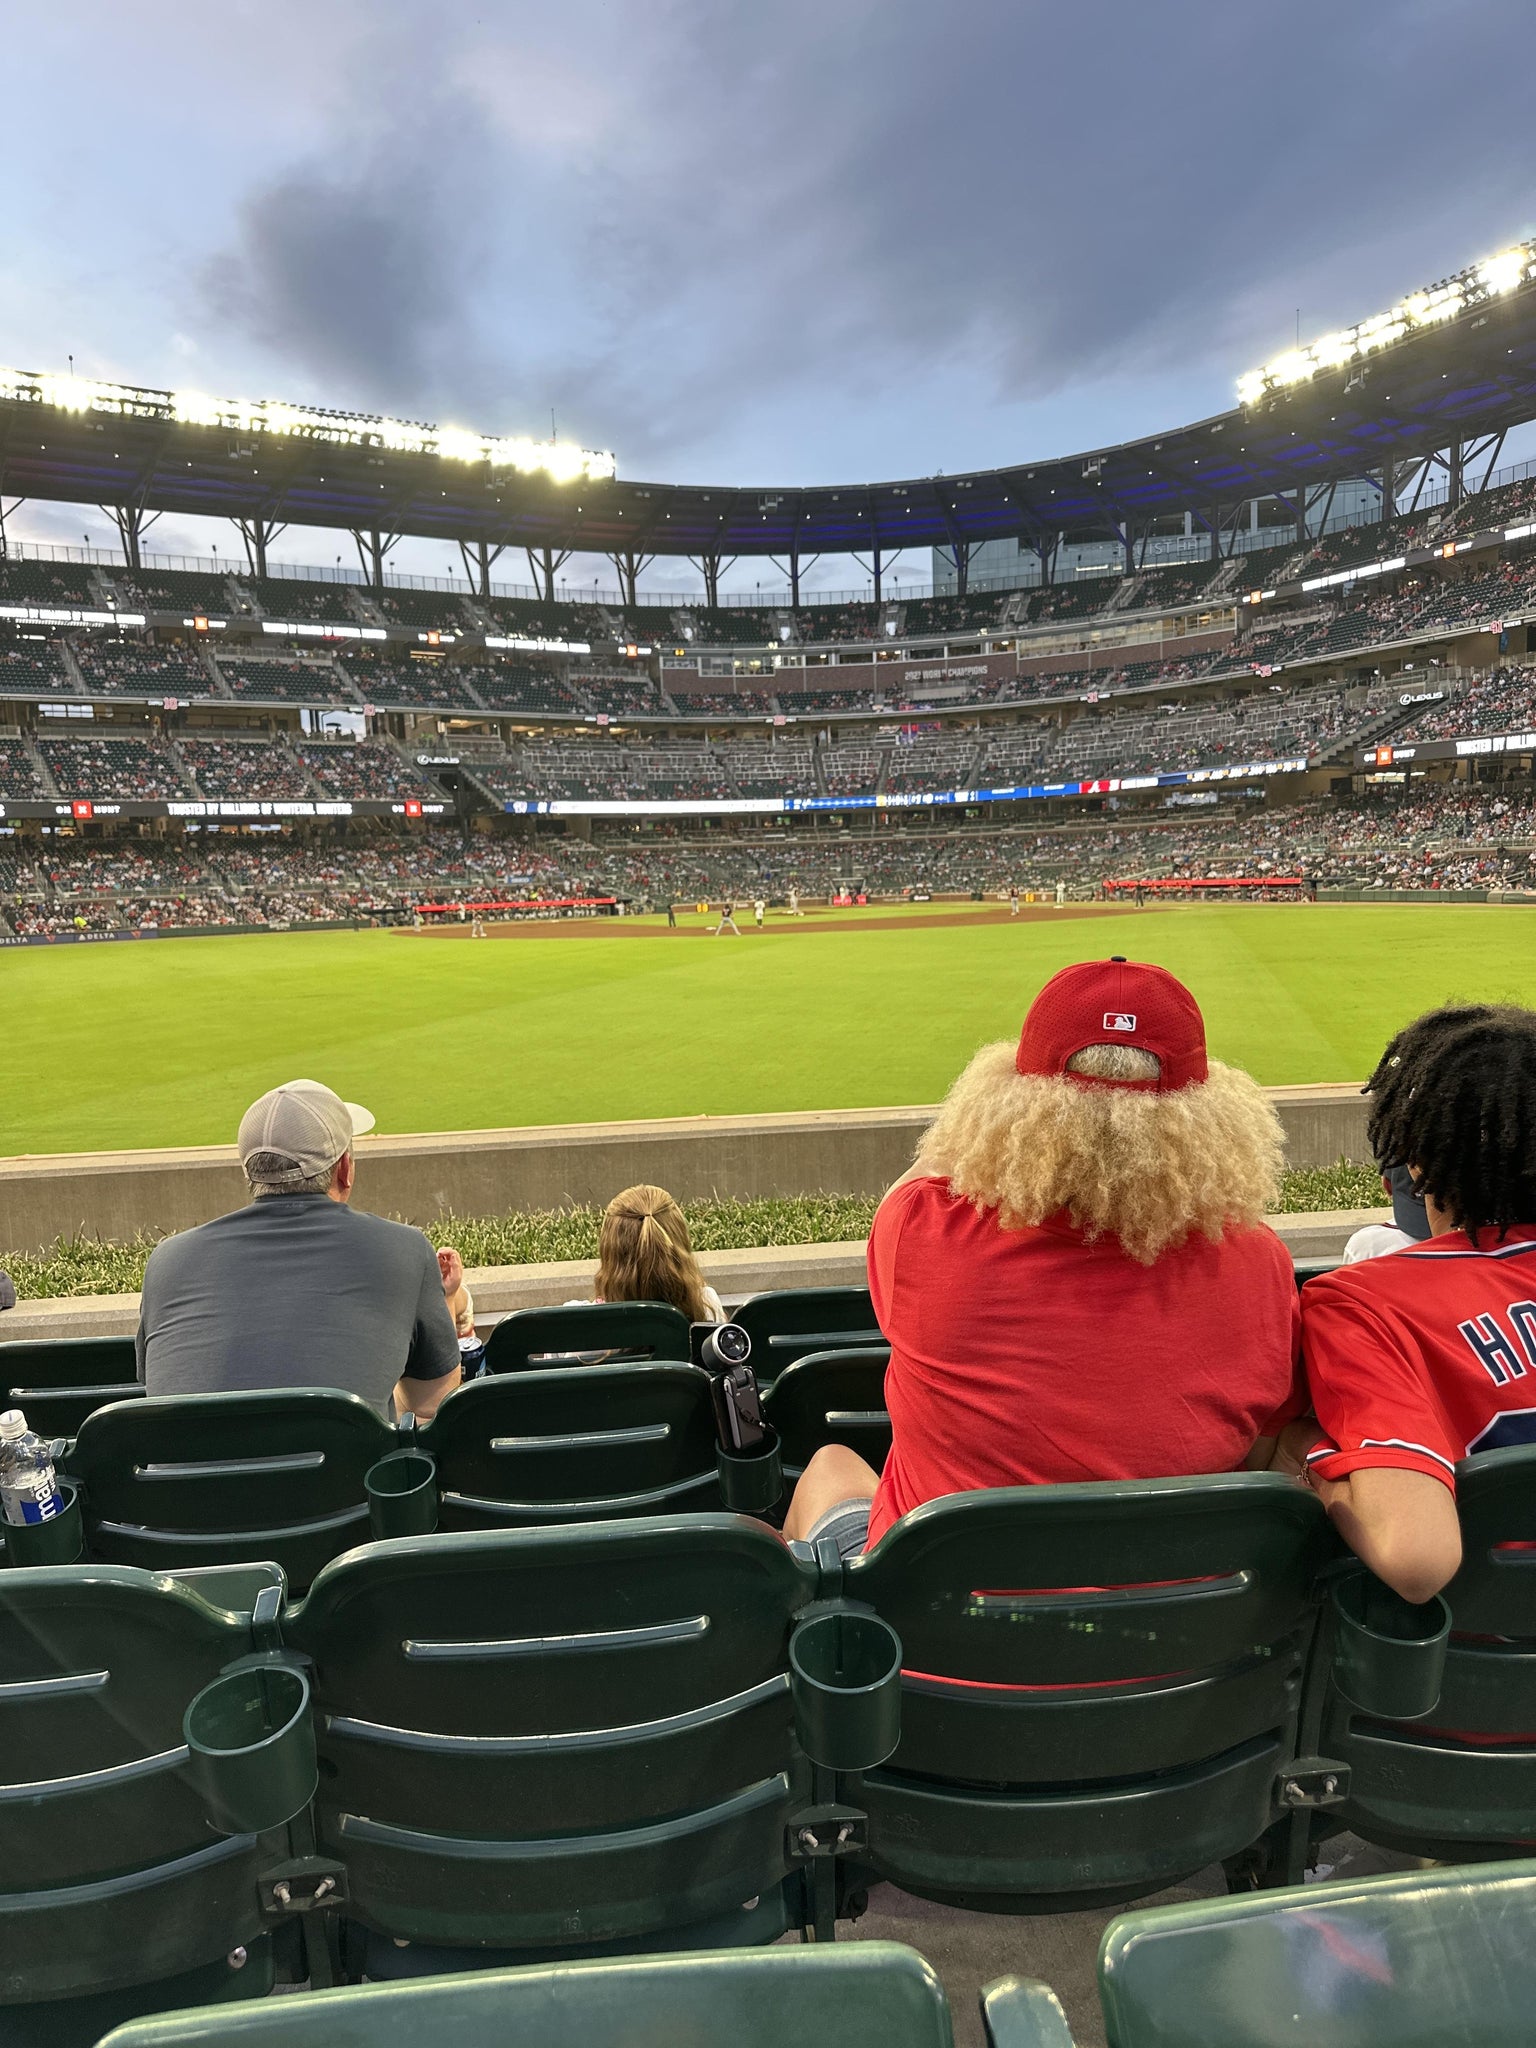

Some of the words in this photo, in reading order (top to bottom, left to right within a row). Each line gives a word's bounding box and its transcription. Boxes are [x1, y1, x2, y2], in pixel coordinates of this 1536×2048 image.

[1115, 541, 1173, 557] TUIST
[948, 665, 988, 677] CHAMPIONS
[1411, 691, 1444, 702] LEXUS
[94, 805, 121, 814] HUNT
[0, 937, 28, 946] DELTA
[87, 933, 115, 942] DELTA
